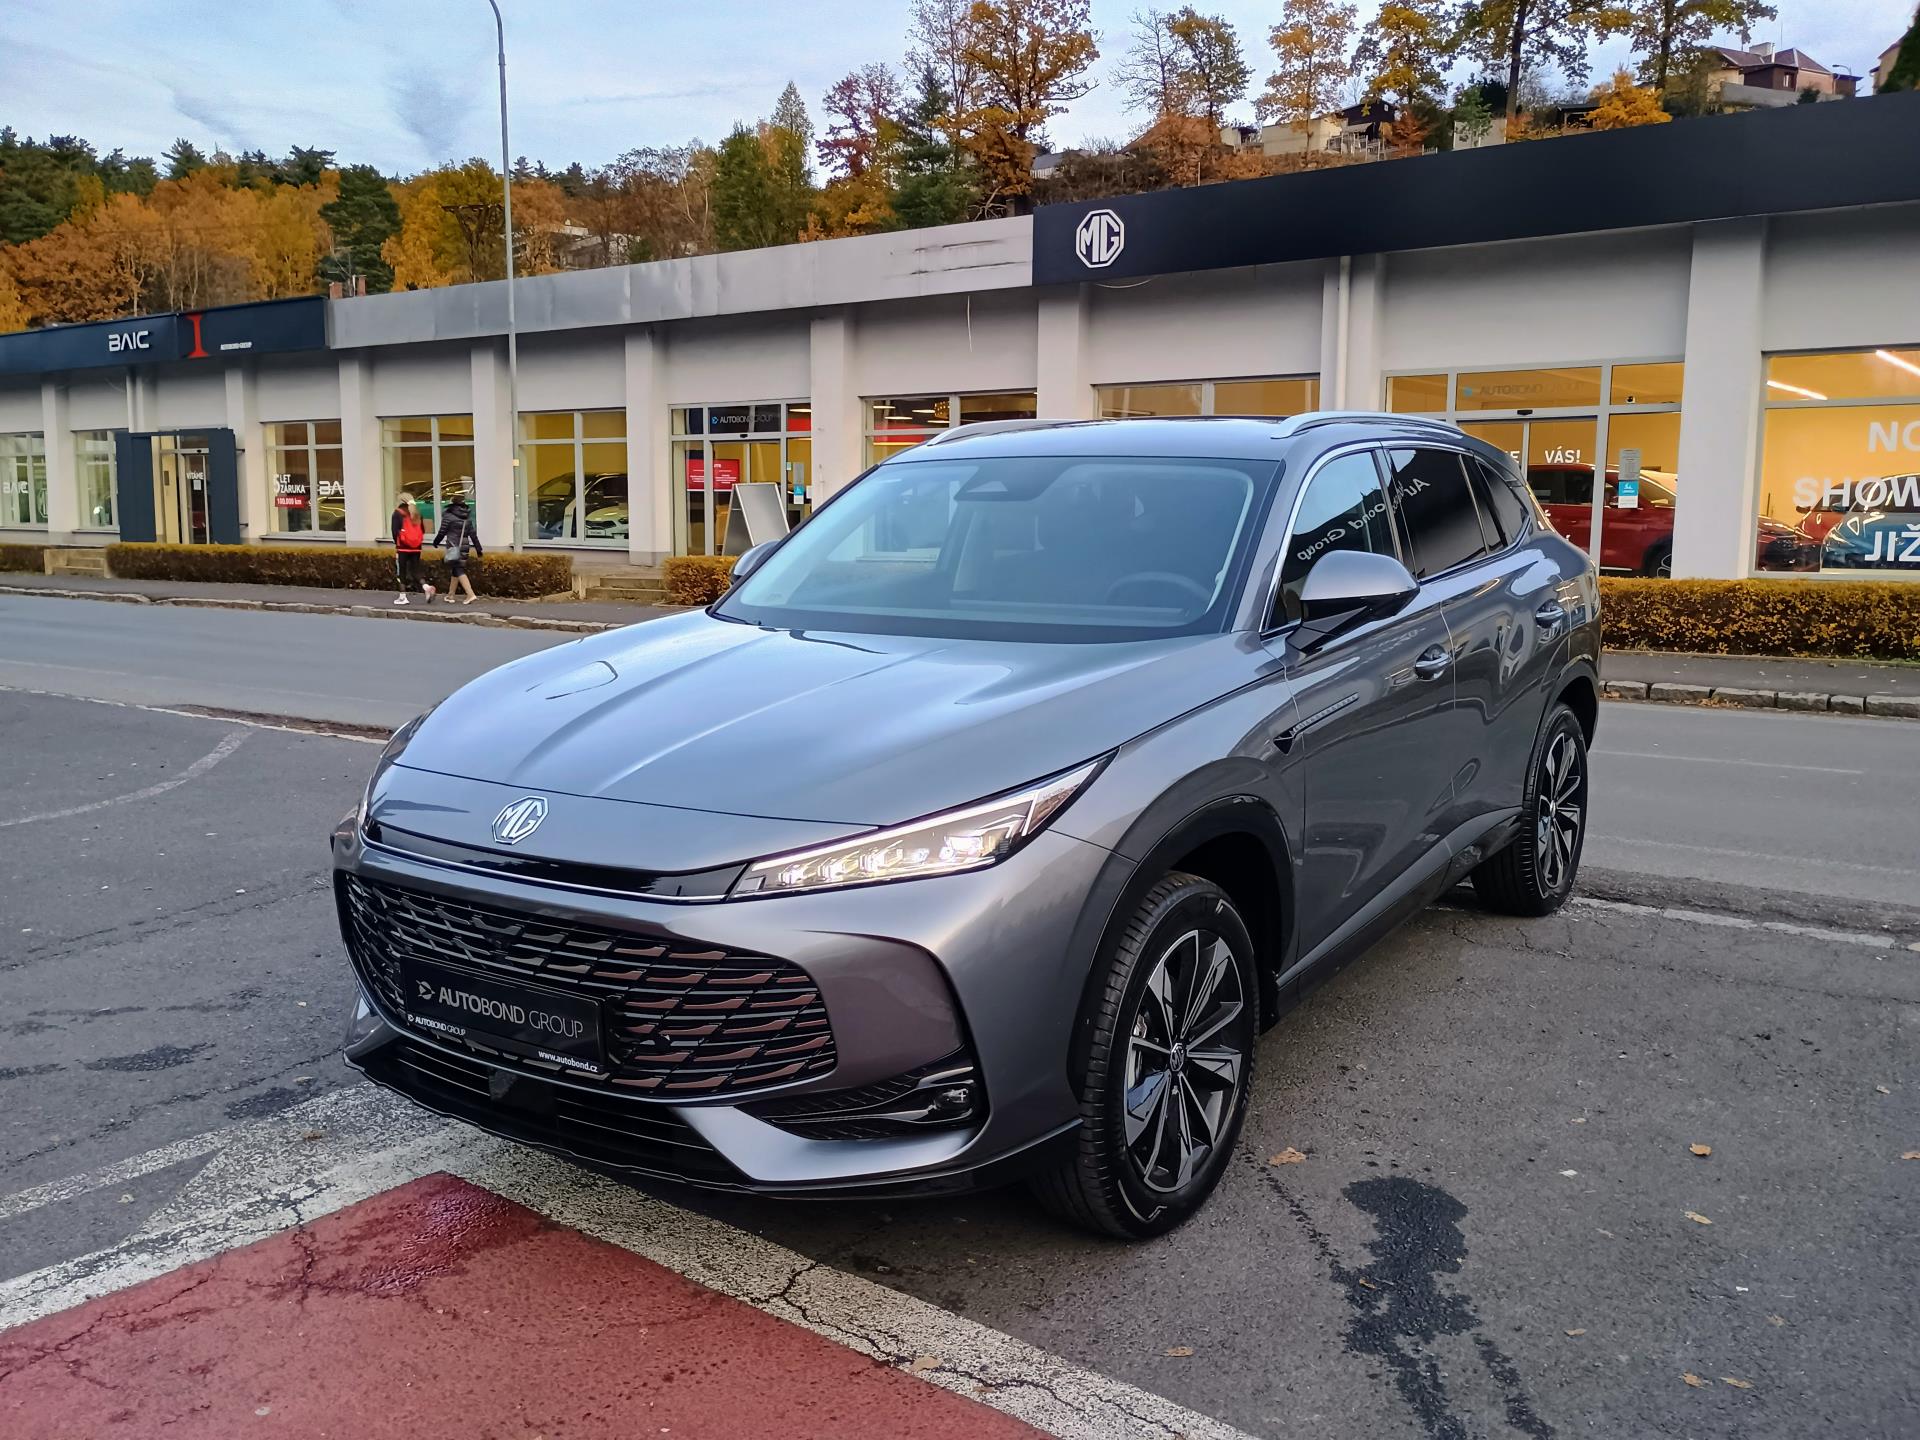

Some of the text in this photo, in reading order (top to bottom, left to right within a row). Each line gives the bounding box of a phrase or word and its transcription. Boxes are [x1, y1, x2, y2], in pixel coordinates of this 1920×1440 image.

[1079, 213, 1121, 264] MG
[108, 330, 150, 352] BAIC
[1544, 446, 1581, 464] VÁS!
[496, 799, 543, 839] MG
[438, 986, 583, 1038] AUTOBOND GROUP
[415, 1016, 466, 1036] AUTOBOND GROUP
[538, 1050, 598, 1073] www.autobond.cz
